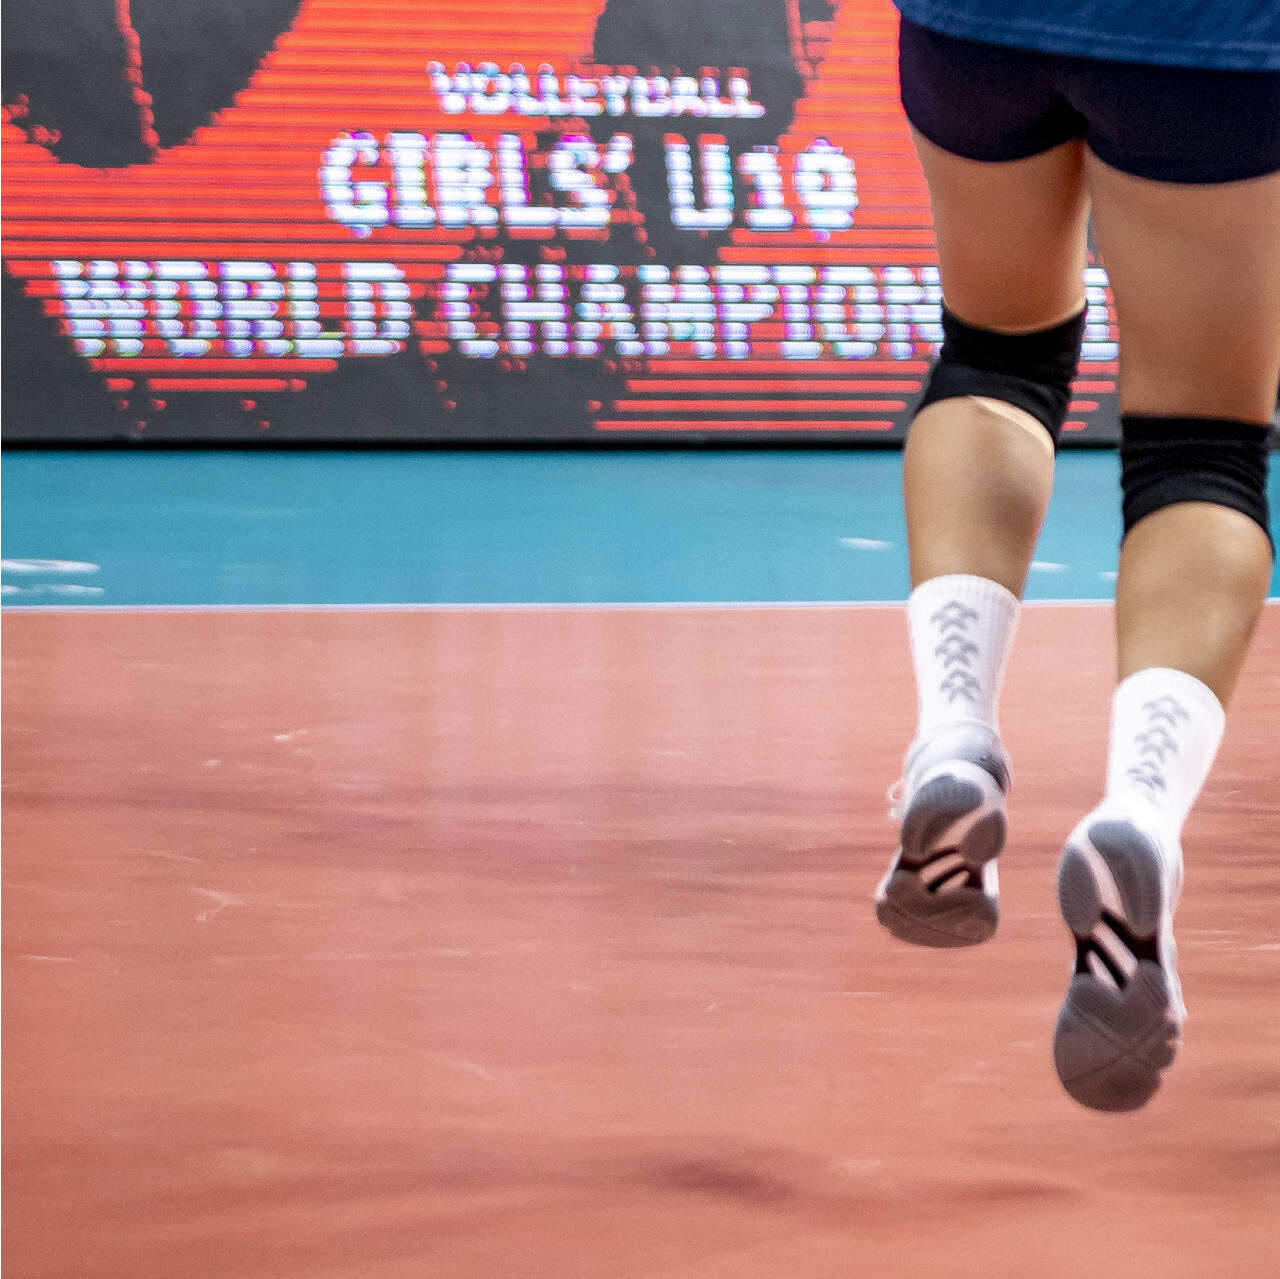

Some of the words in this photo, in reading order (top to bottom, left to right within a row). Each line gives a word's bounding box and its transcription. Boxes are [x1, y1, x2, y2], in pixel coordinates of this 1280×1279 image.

[427, 60, 766, 118] VOLLEYBALL
[51, 259, 411, 359] WORLD
[440, 262, 1119, 361] CHAMPION
